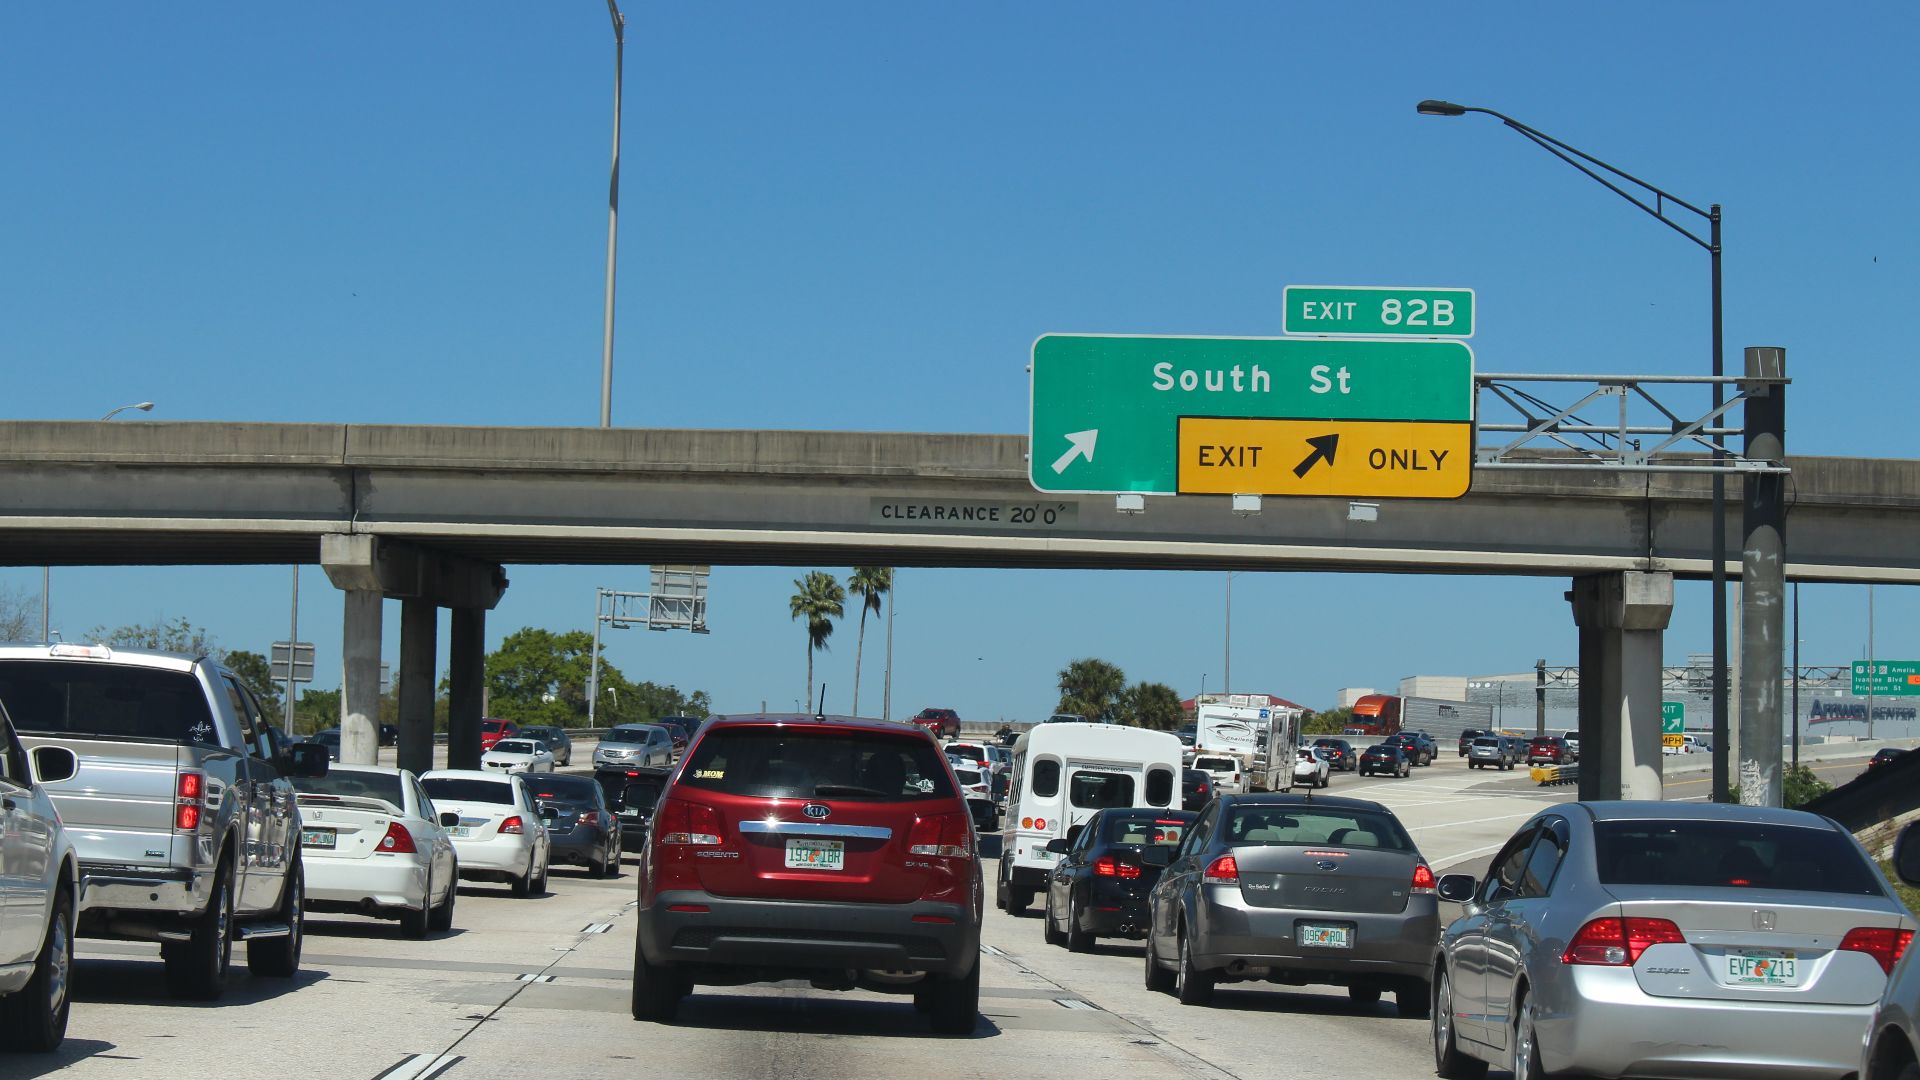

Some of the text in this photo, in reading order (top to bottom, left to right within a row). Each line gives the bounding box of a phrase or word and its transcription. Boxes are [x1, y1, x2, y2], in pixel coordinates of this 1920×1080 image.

[1303, 299, 1454, 326] EXIT 82B
[1152, 362, 1351, 394] South St
[1199, 446, 1449, 471] EXIT ONLY
[881, 504, 1000, 521] CLEARANCE
[1662, 705, 1676, 713] XIT
[807, 807, 826, 816] KIA
[789, 847, 808, 862] 193
[1729, 957, 1795, 977] EVF Z13
